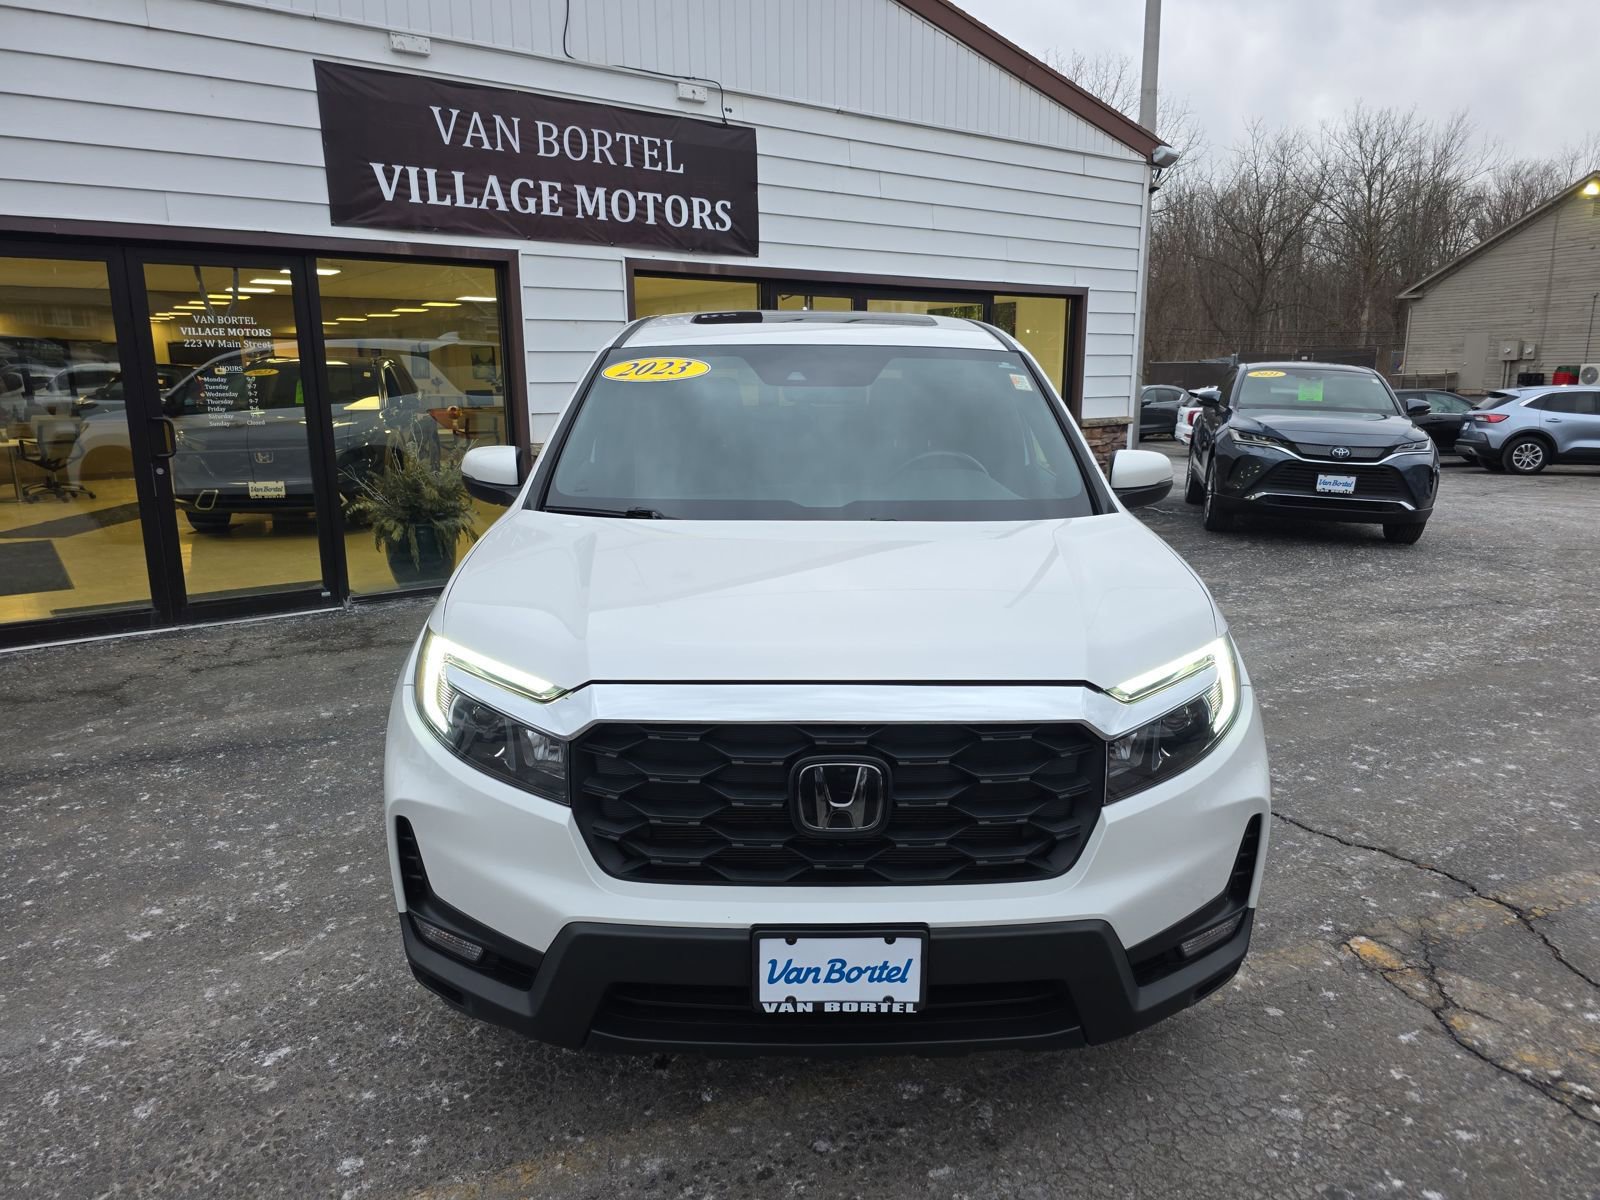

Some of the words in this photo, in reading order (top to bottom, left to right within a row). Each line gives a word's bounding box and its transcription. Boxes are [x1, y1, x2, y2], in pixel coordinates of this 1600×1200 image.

[429, 105, 520, 154] VAN
[535, 120, 684, 174] BORTEL
[369, 162, 563, 217] VILLAGE
[576, 184, 733, 232] MOTORS
[192, 315, 215, 325] VAN
[217, 315, 257, 325] BORTEL
[180, 327, 226, 337] VILLAGE
[227, 328, 272, 337] MOTORS
[183, 339, 203, 348] 223
[204, 340, 216, 348] W
[217, 340, 241, 348] Main
[243, 340, 272, 349] Street
[615, 361, 693, 377] 2023
[767, 958, 821, 984] Van
[823, 958, 914, 984] Bortel
[762, 1002, 813, 1013] VAN
[824, 1002, 917, 1014] BORTEL
